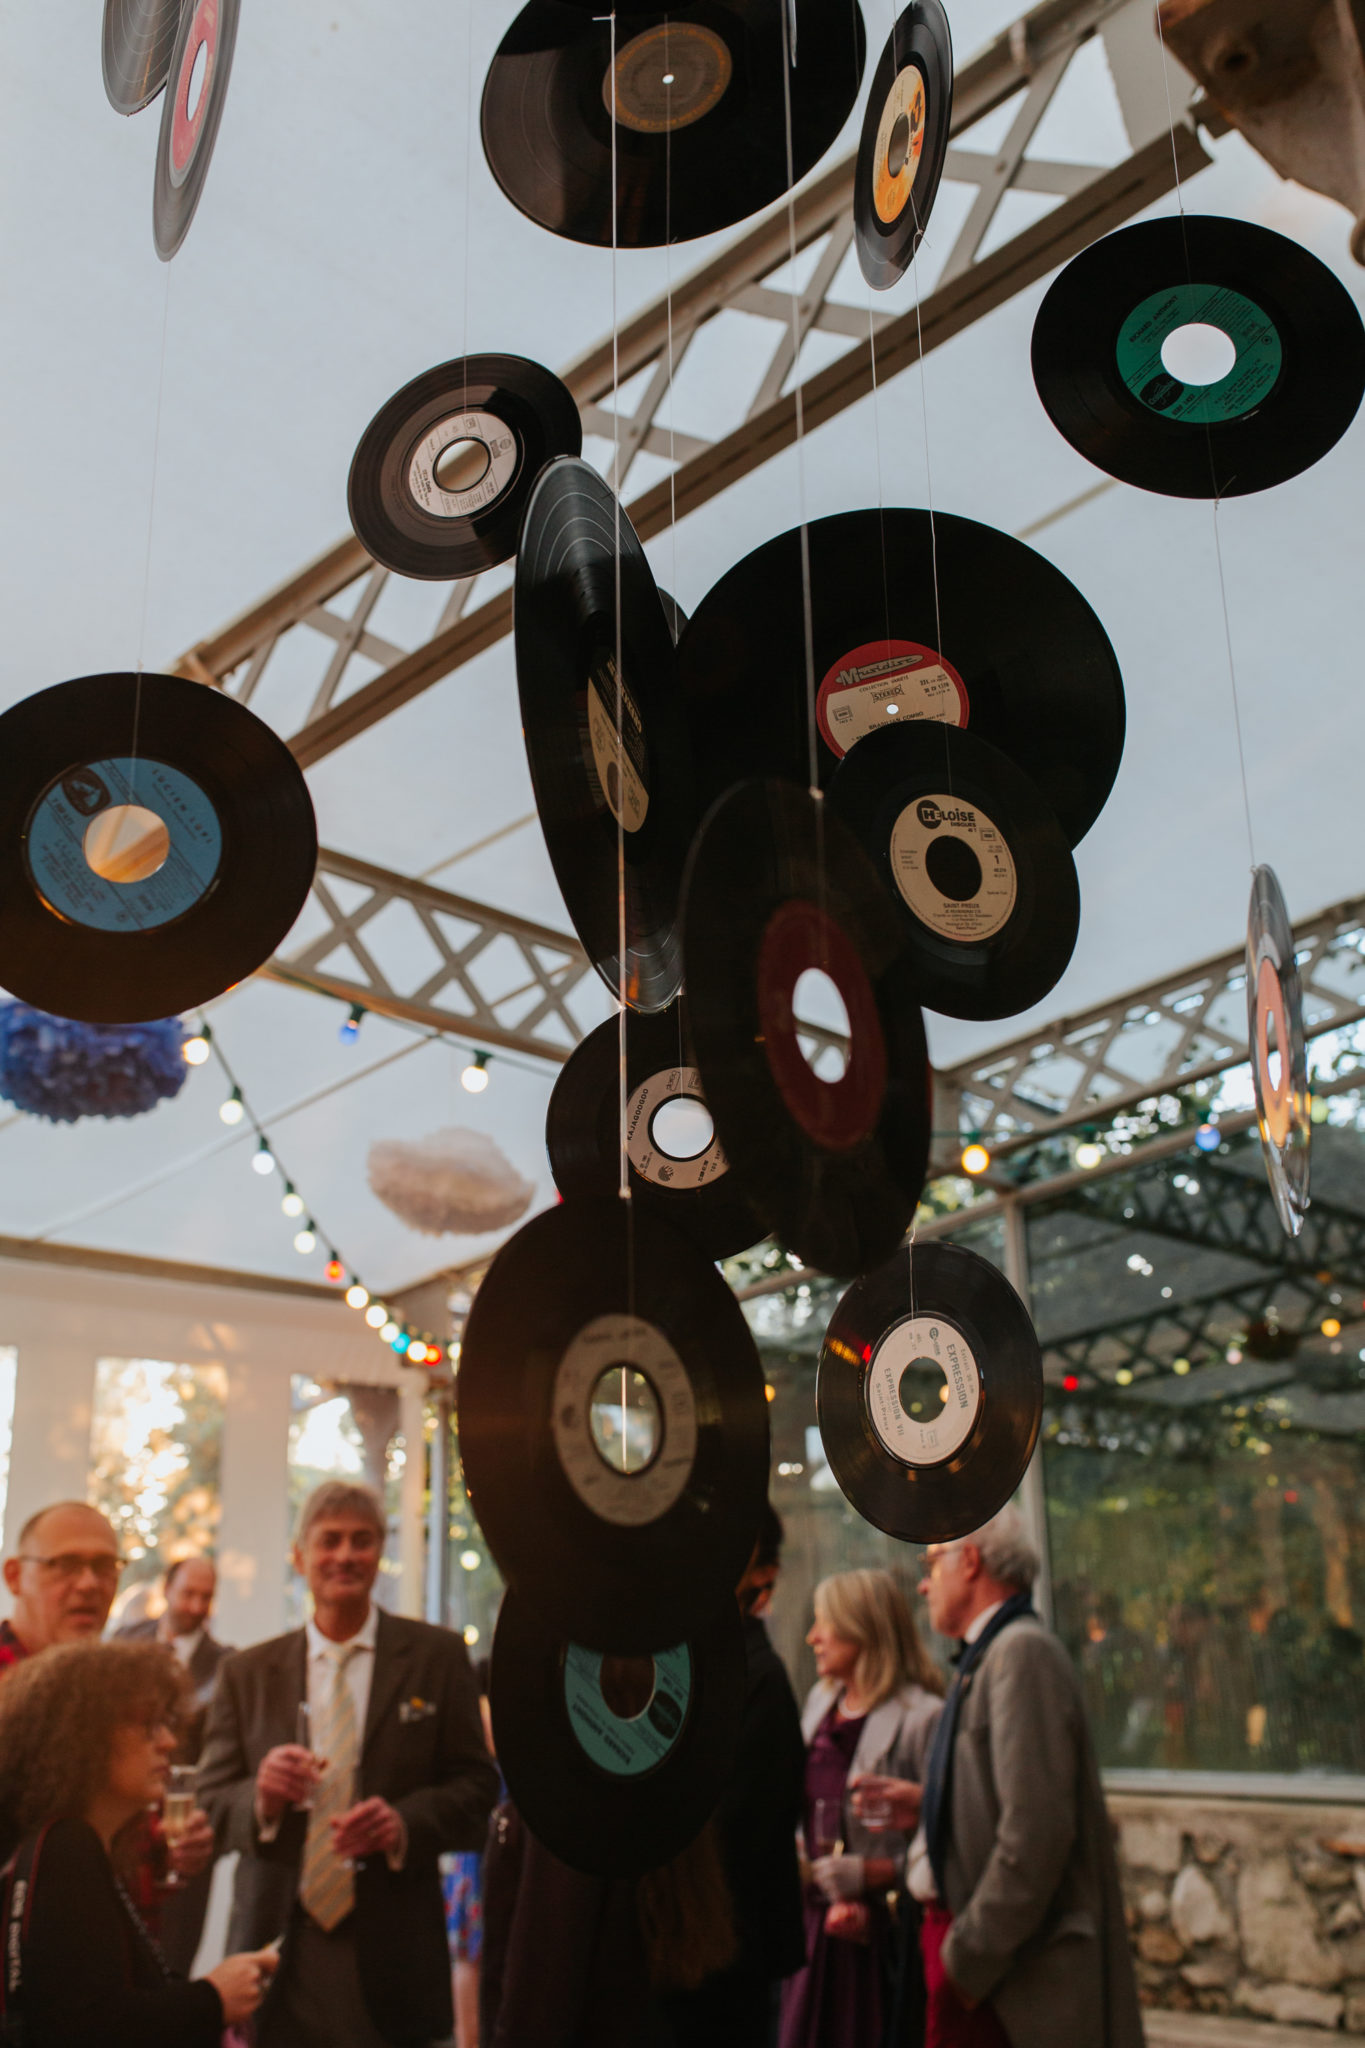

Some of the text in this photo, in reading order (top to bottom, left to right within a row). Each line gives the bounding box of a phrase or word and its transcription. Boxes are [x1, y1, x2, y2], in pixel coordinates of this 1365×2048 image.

[627, 1088, 649, 1141] KAJAGOOGOO
[884, 1368, 902, 1421] EXPRESSION
[946, 1343, 969, 1409] EXPRESSION
